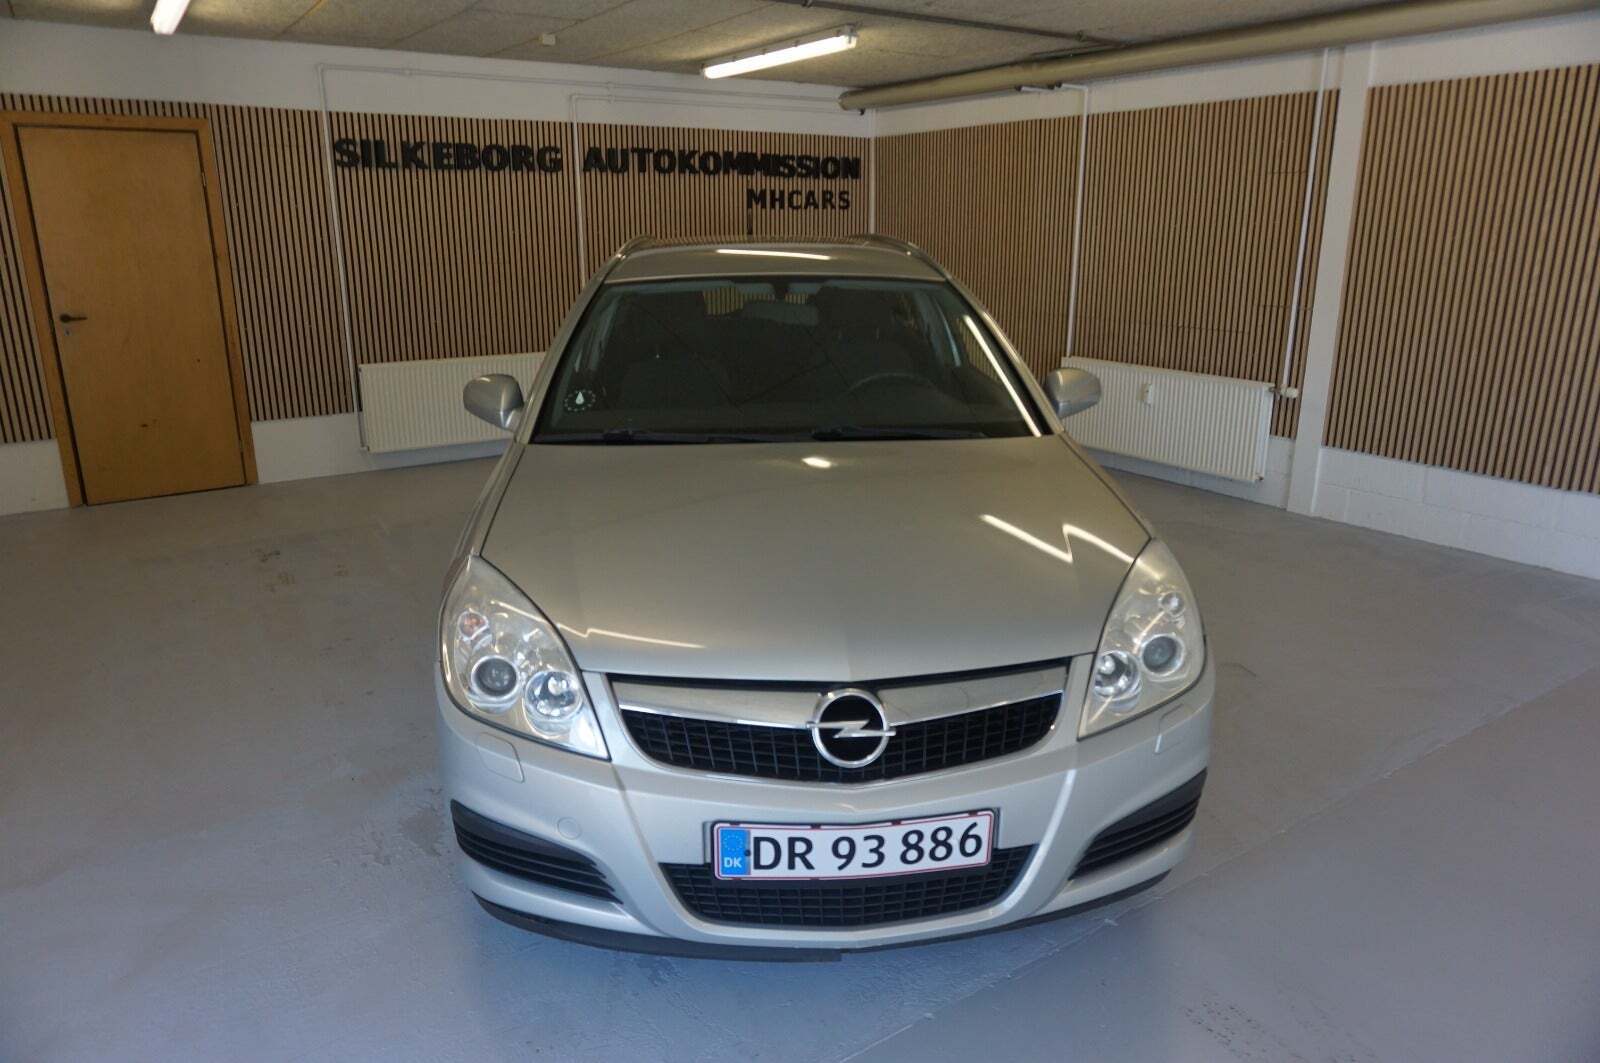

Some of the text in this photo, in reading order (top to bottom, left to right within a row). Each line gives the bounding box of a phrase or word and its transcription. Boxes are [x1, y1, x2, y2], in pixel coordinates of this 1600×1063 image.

[334, 138, 861, 179] SILKEBORG AUTOKOMMISSION
[746, 189, 850, 210] MHCARS
[752, 821, 983, 870] DR 93 886
[724, 856, 742, 868] DK
